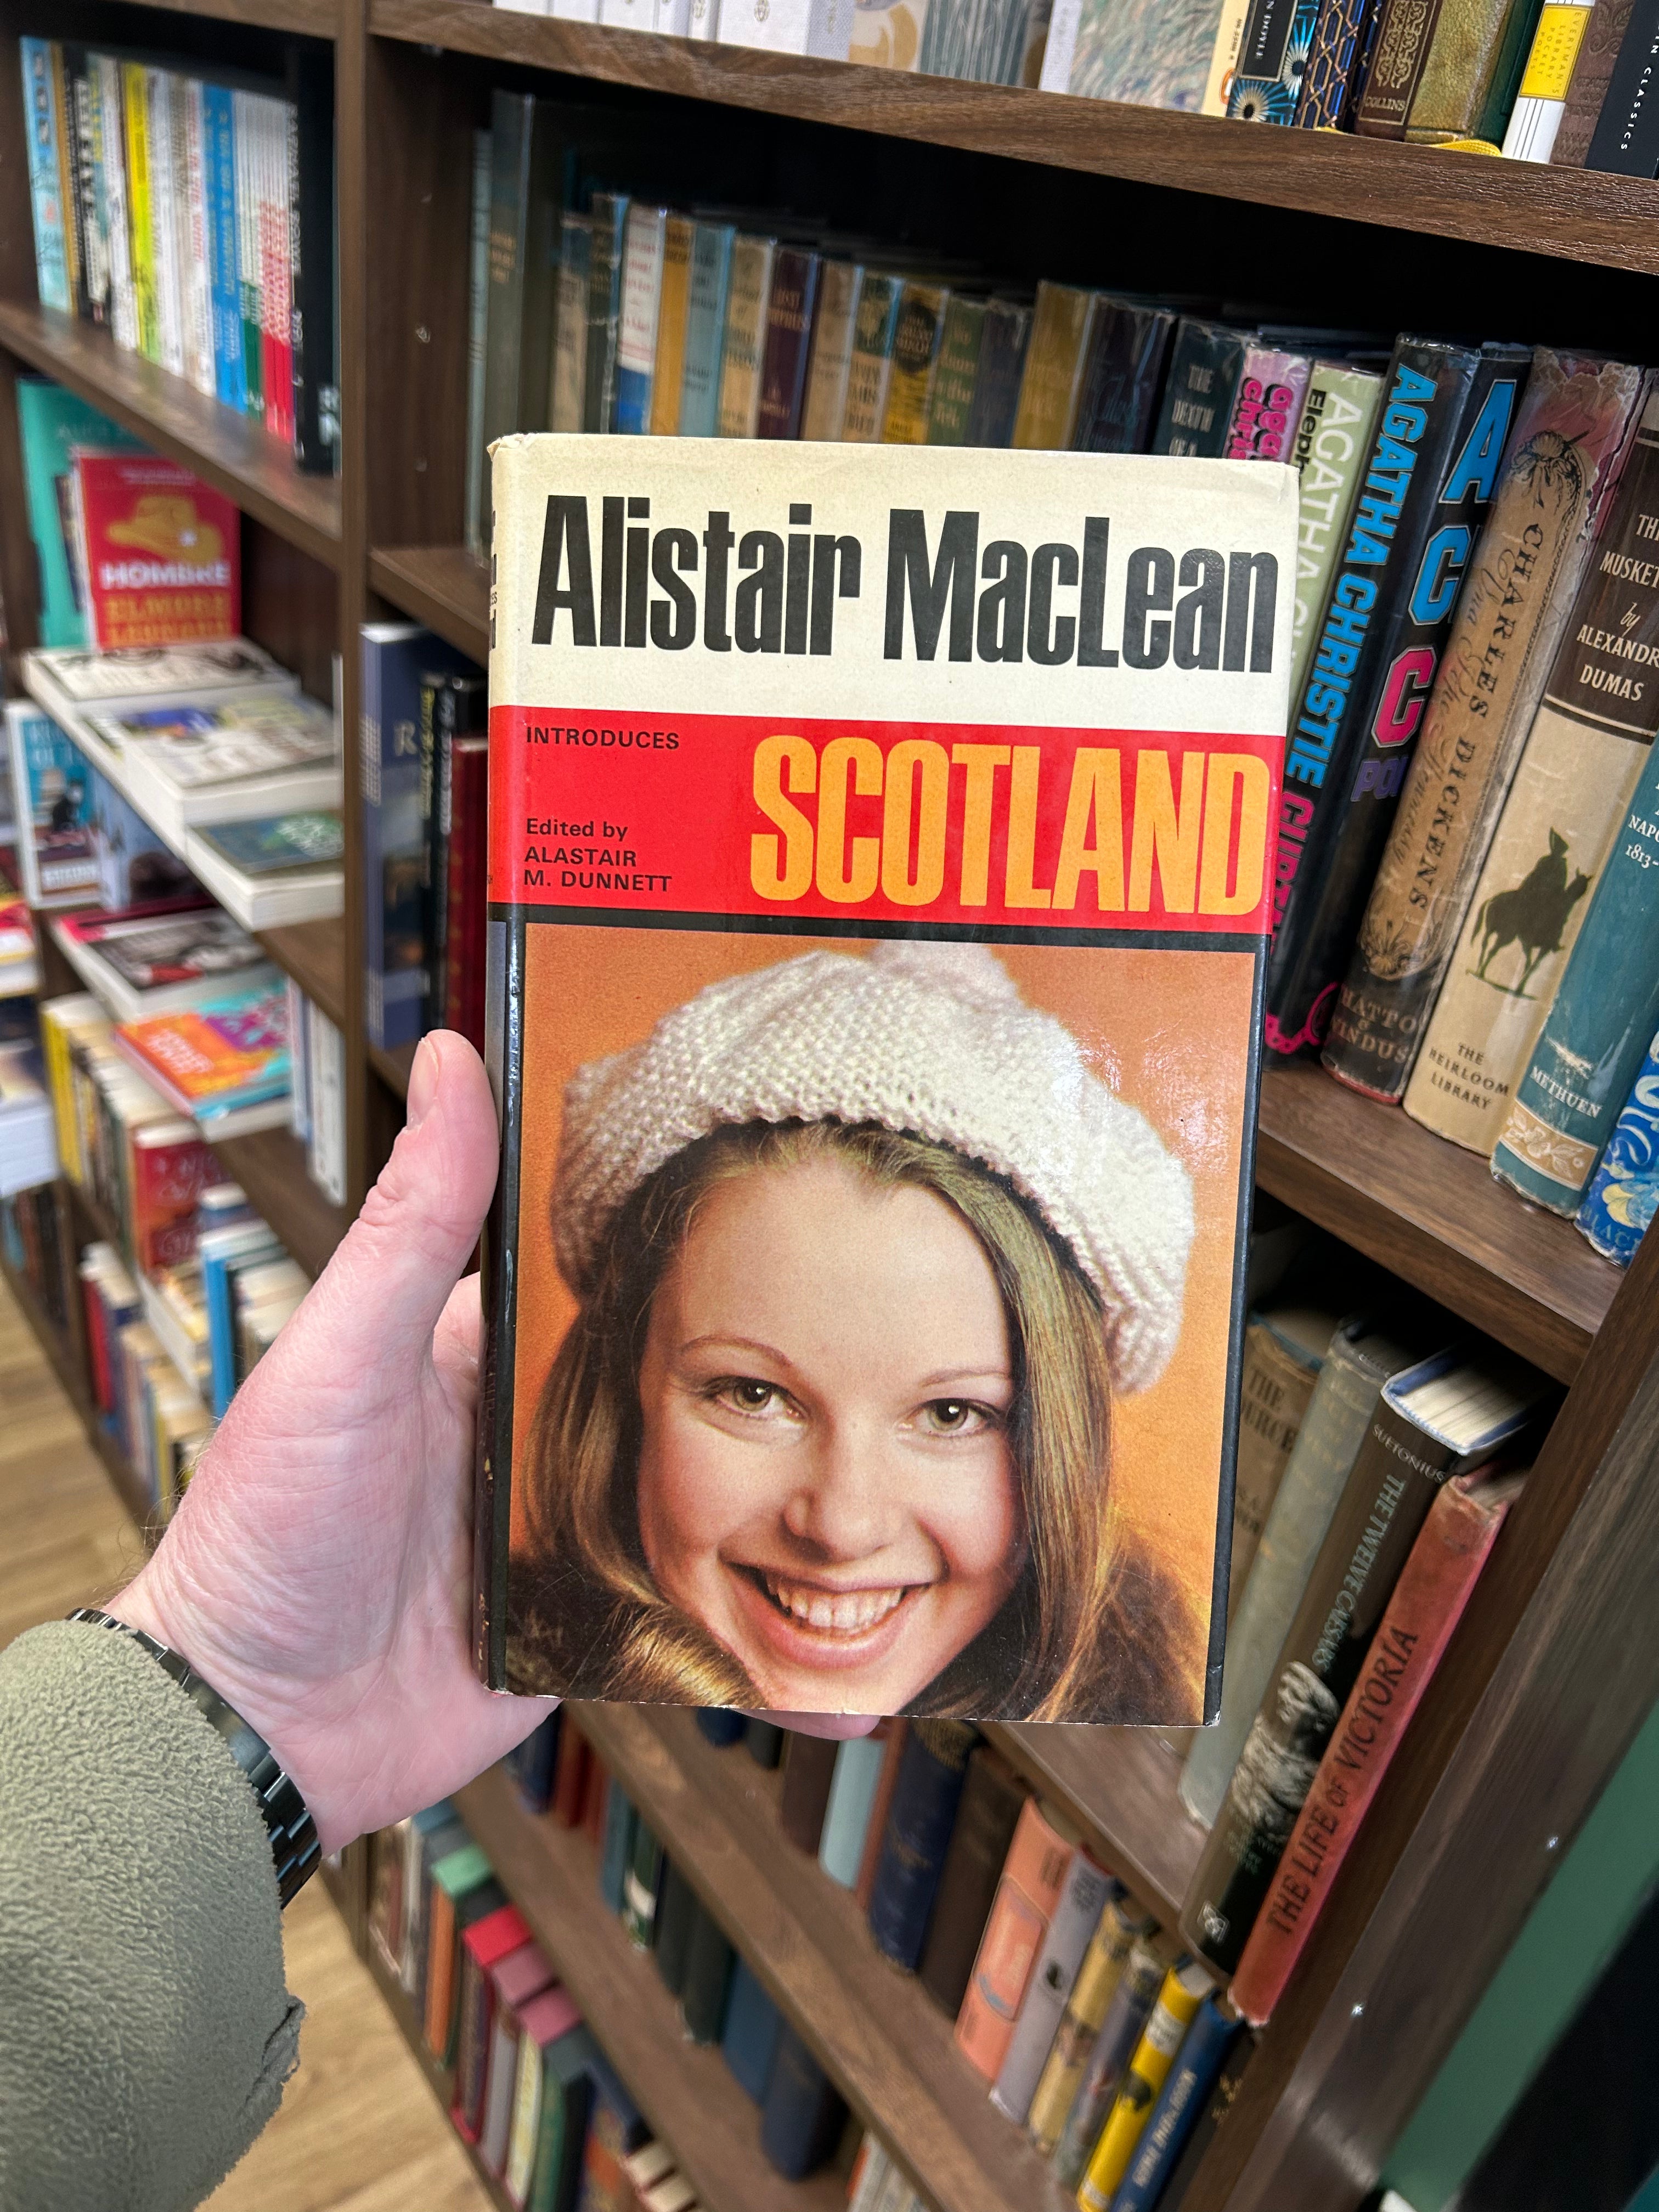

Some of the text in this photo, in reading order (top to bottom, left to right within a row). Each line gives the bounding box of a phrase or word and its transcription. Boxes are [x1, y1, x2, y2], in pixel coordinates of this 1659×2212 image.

[1537, 27, 1555, 75] POCKET
[1546, 25, 1566, 79] LIBRARY
[1552, 12, 1582, 94] EVERYMAN'S
[1364, 95, 1406, 111] COLLINS
[1621, 66, 1652, 150] CLASSICS
[1255, 385, 1293, 461] aga
[1297, 392, 1364, 579] AGATHA
[532, 494, 862, 656] Alistair
[883, 509, 1279, 673] MacLean
[1285, 363, 1438, 788] AGATHA CHRISTIE
[1620, 602, 1641, 637] by
[1576, 624, 1659, 668] ALEXANDR
[1579, 663, 1644, 702] DUMAS
[526, 727, 679, 750] INTRODUCES
[1409, 523, 1543, 911] CHARLES DICKENS
[526, 818, 628, 841] Edited by
[751, 735, 1271, 916] SCOTLAND
[524, 847, 636, 867] ALASTAIR
[524, 869, 673, 893] M. DUNNETT
[1429, 1048, 1510, 1096] HEIRLOOM
[1458, 1043, 1484, 1065] THE
[1431, 1071, 1492, 1109] LIBRARY
[1530, 1065, 1602, 1118] METHUEN
[1372, 1424, 1446, 1482] SUETONIUS
[1375, 1475, 1406, 1519] THE
[1343, 1515, 1390, 1595] TWELVE
[1266, 1626, 1419, 1935] THE LIFE OF VICTORIA
